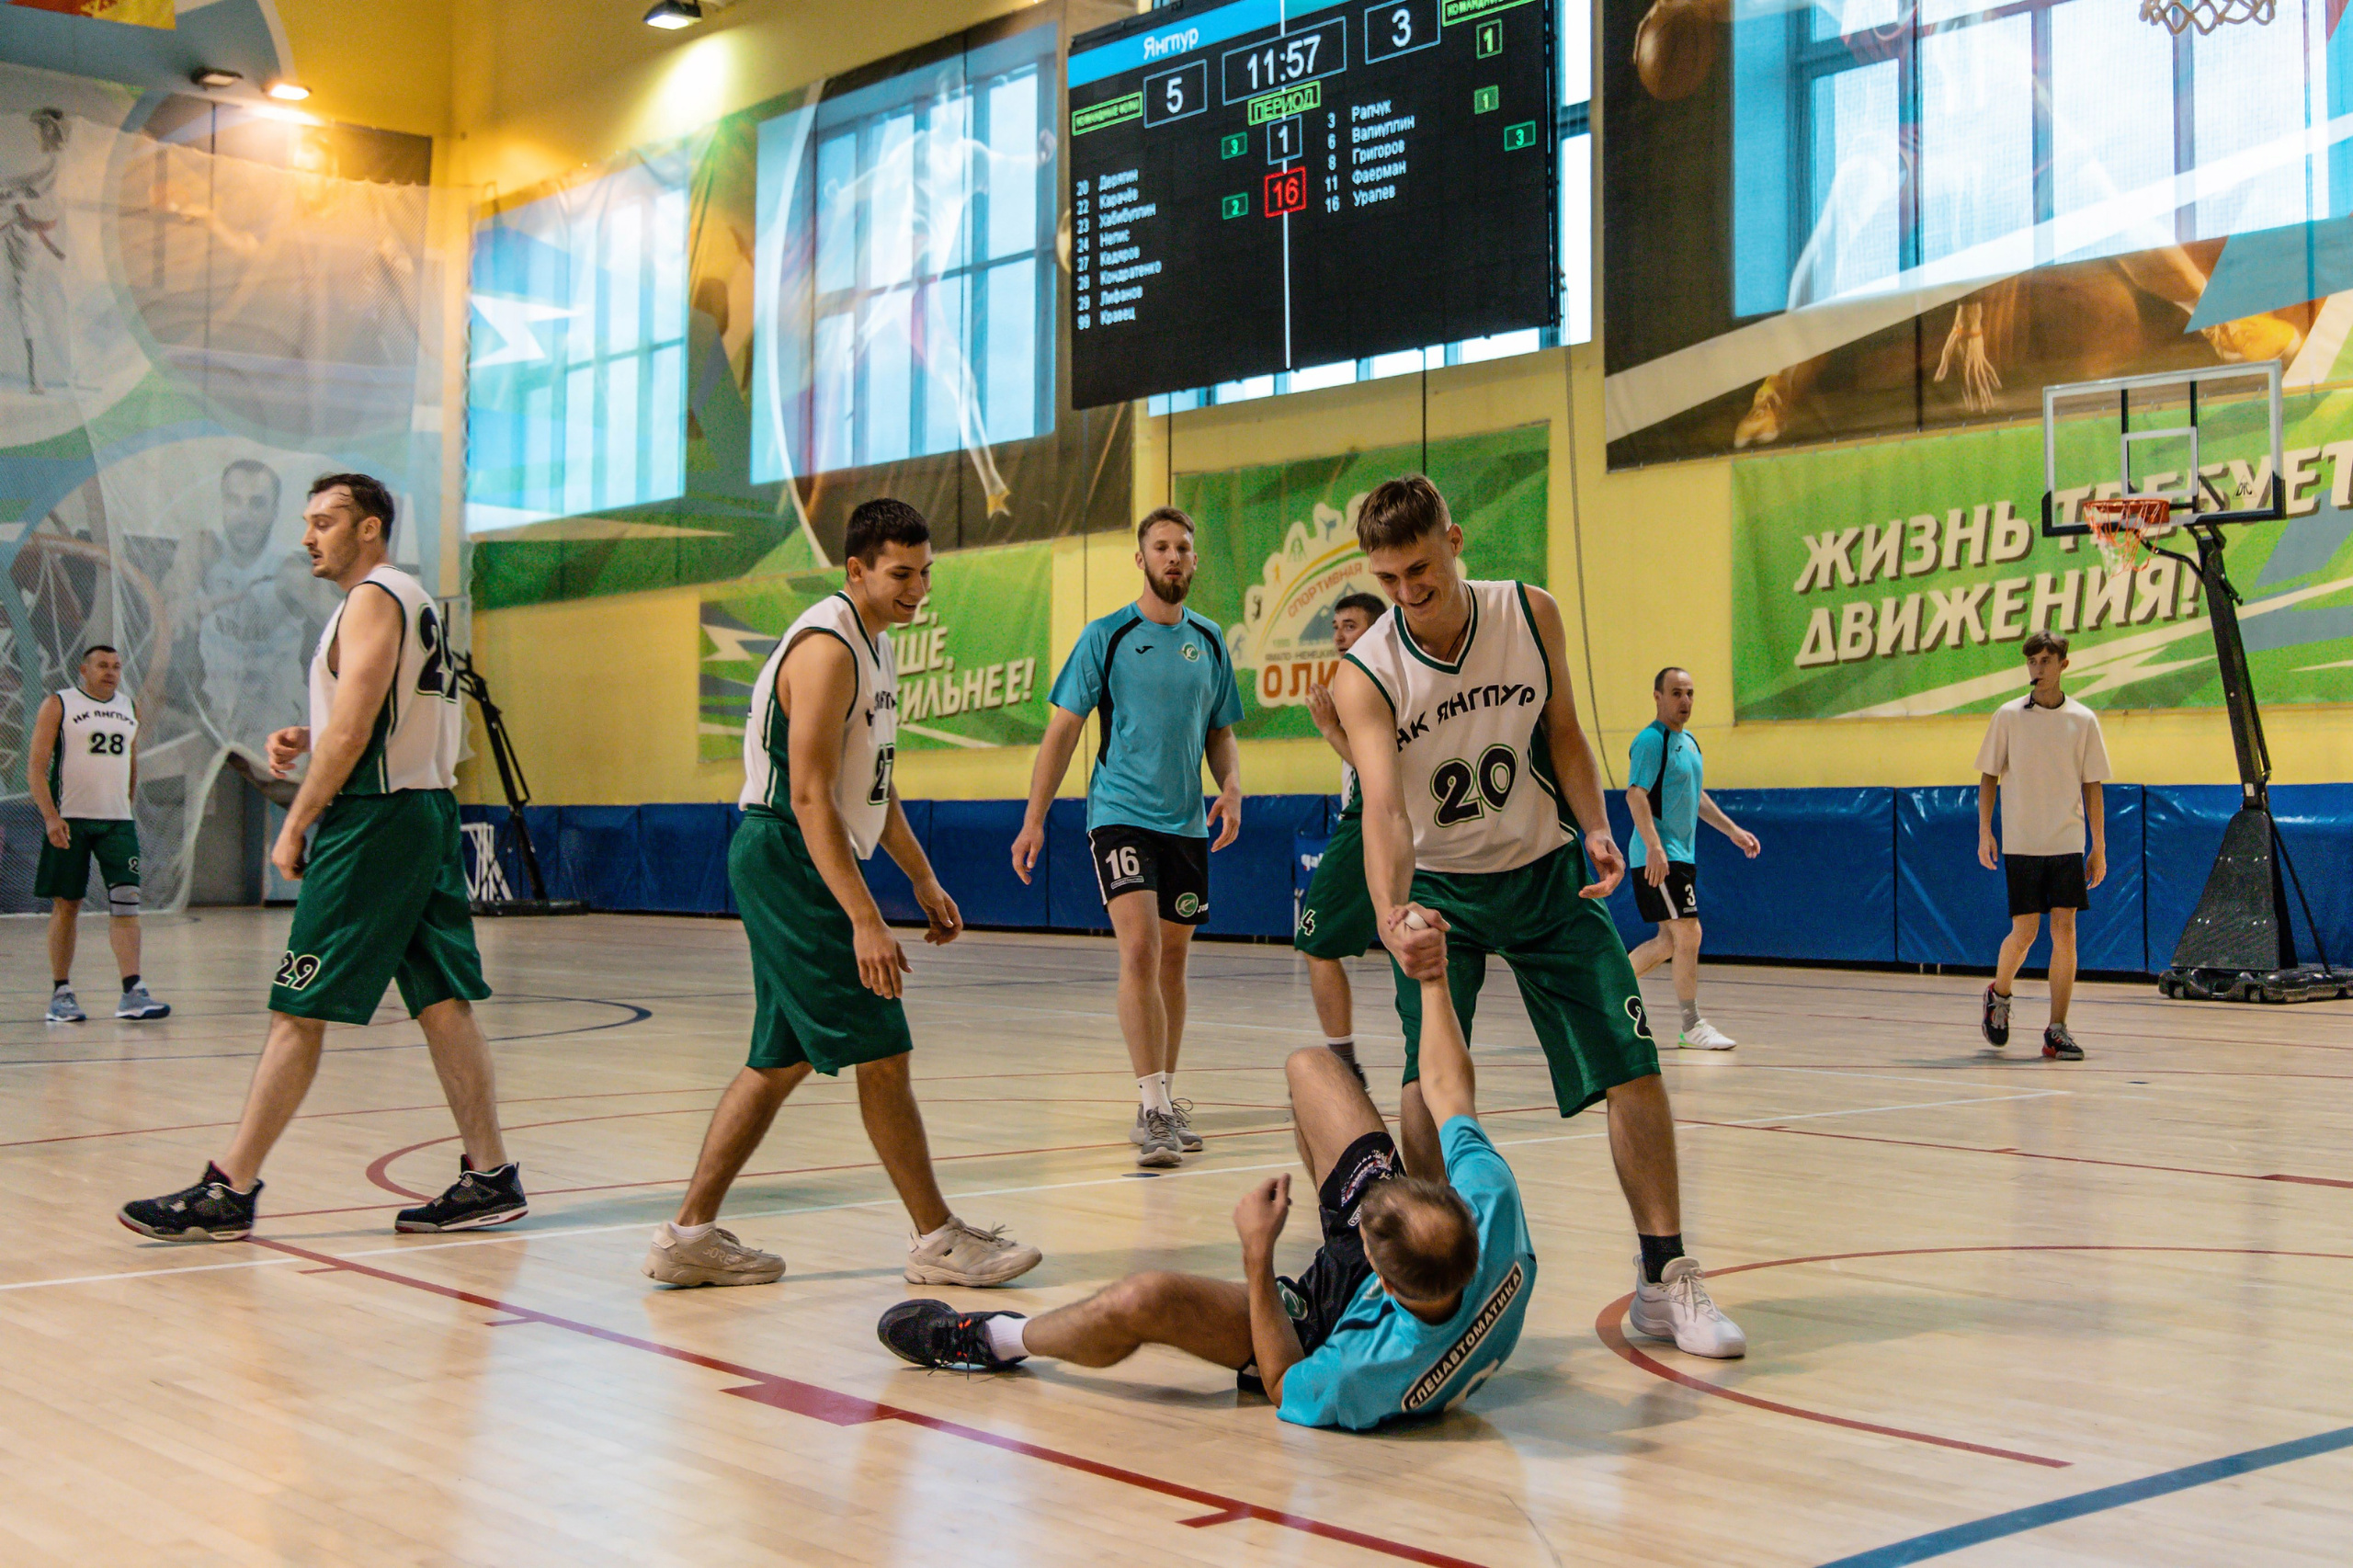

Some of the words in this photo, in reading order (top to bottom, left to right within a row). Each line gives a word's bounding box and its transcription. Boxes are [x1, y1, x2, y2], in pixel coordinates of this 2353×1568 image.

[1392, 8, 1412, 47] 3
[1483, 28, 1494, 52] 1
[1246, 34, 1321, 90] 11:57
[1165, 76, 1184, 114] 5
[1254, 87, 1314, 121] ПЕРИОД
[1482, 93, 1490, 109] 1
[1327, 112, 1336, 129] 3
[1230, 139, 1239, 155] 3
[1278, 125, 1289, 153] 1
[1327, 133, 1336, 150] 6
[1516, 129, 1525, 146] 3
[1328, 154, 1336, 170] 8
[1352, 139, 1405, 165] Григоров
[1324, 175, 1338, 192] 11
[1352, 160, 1407, 185] Фаерман
[1076, 199, 1090, 215] 22
[1231, 199, 1240, 216] 2
[1272, 176, 1300, 209] 16
[1324, 195, 1340, 213] 16
[1076, 217, 1090, 234] 23
[1077, 256, 1090, 272] 27
[1794, 501, 2033, 595] ЖИЗНЬ
[1288, 562, 1363, 619] СПОРТИВНАЯ
[1794, 551, 2205, 669] ДВИЖЕНИЯ!
[1437, 684, 1536, 726] ЯНГПУР
[89, 731, 125, 756] 28
[1430, 743, 1519, 828] 20
[1105, 846, 1140, 881] 16
[1684, 883, 1697, 906] 3
[273, 950, 322, 991] 29
[1408, 1272, 1521, 1409] СПЕЦАВТОМАТИКА
